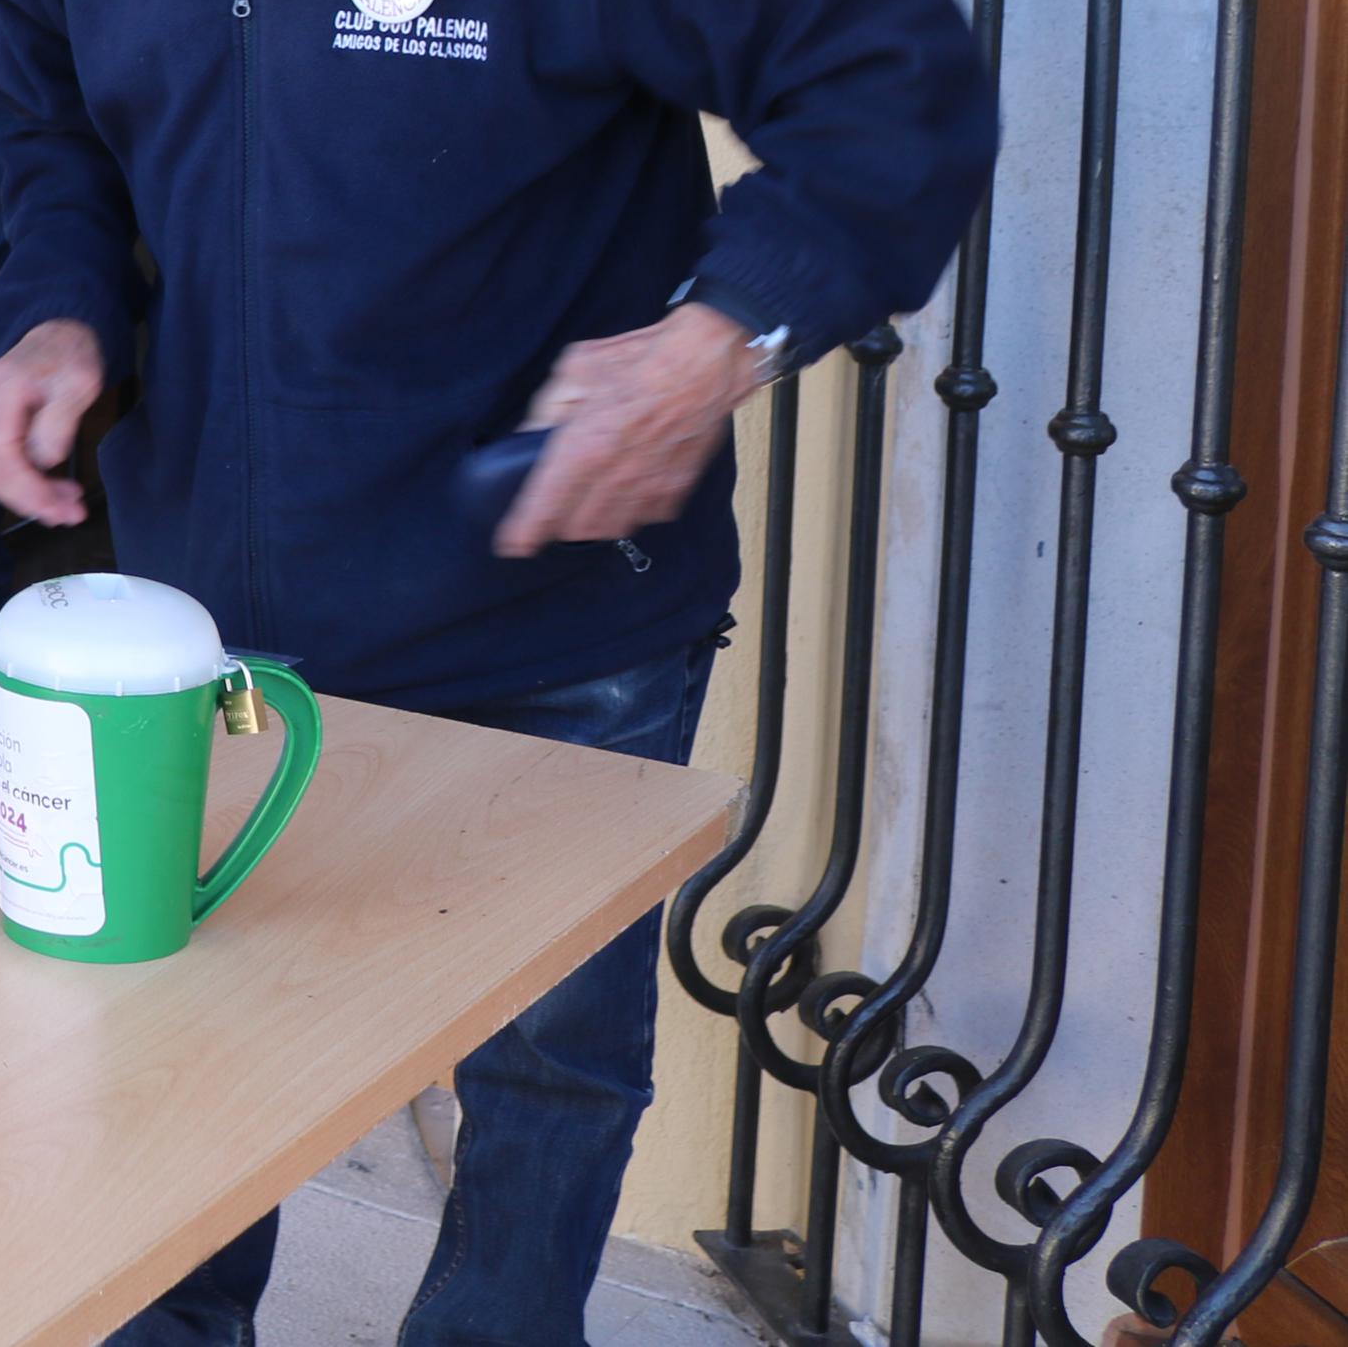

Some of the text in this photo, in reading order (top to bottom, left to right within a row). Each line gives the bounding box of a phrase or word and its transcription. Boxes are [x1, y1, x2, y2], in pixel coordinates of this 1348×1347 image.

[335, 10, 373, 31] CLUB
[416, 16, 488, 42] PALENCIA
[333, 33, 381, 51] AMIGOS
[384, 37, 400, 52] DE
[402, 38, 426, 56] LOS
[13, 785, 71, 811] cáncer
